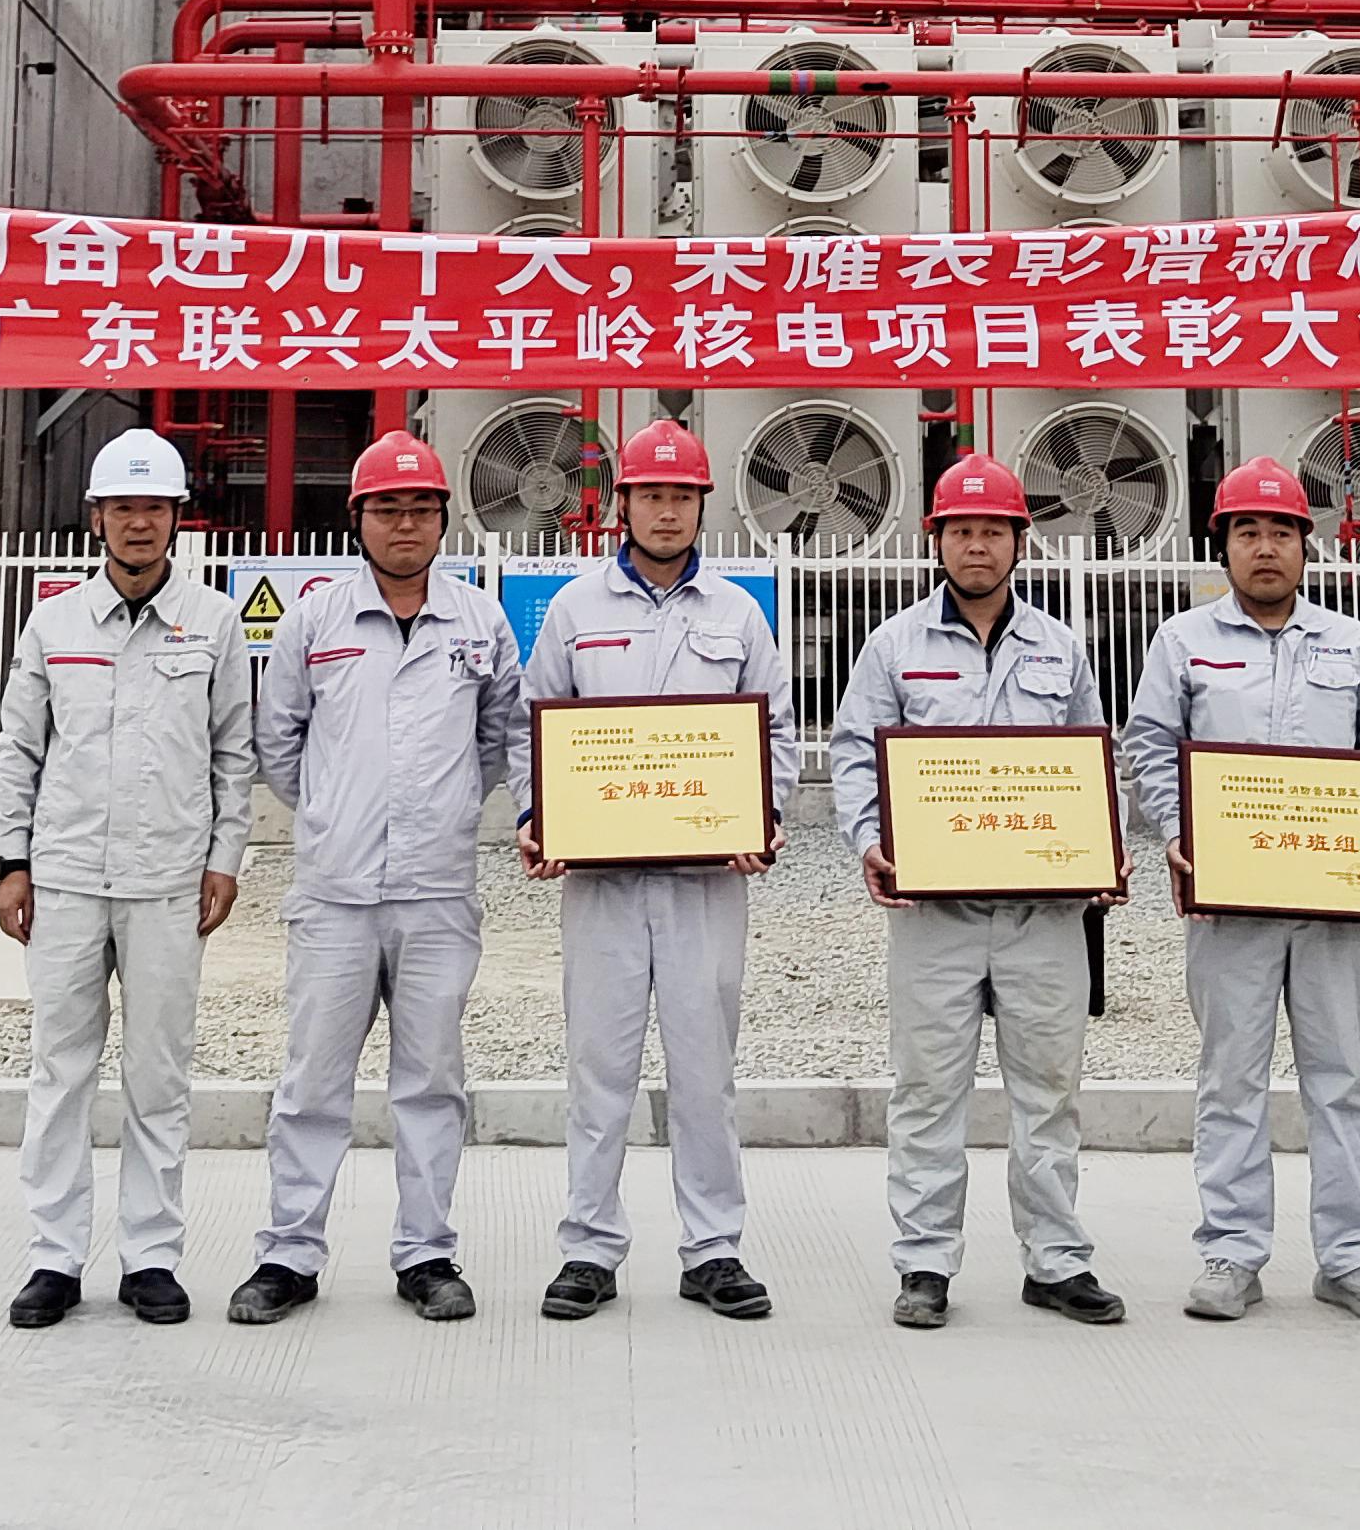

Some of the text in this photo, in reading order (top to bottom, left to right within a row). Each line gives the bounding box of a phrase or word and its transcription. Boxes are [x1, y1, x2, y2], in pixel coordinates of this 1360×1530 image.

[597, 780, 709, 802] 金牌班组
[947, 812, 1058, 833] 金牌班组
[1248, 830, 1360, 854] 金牌班组
